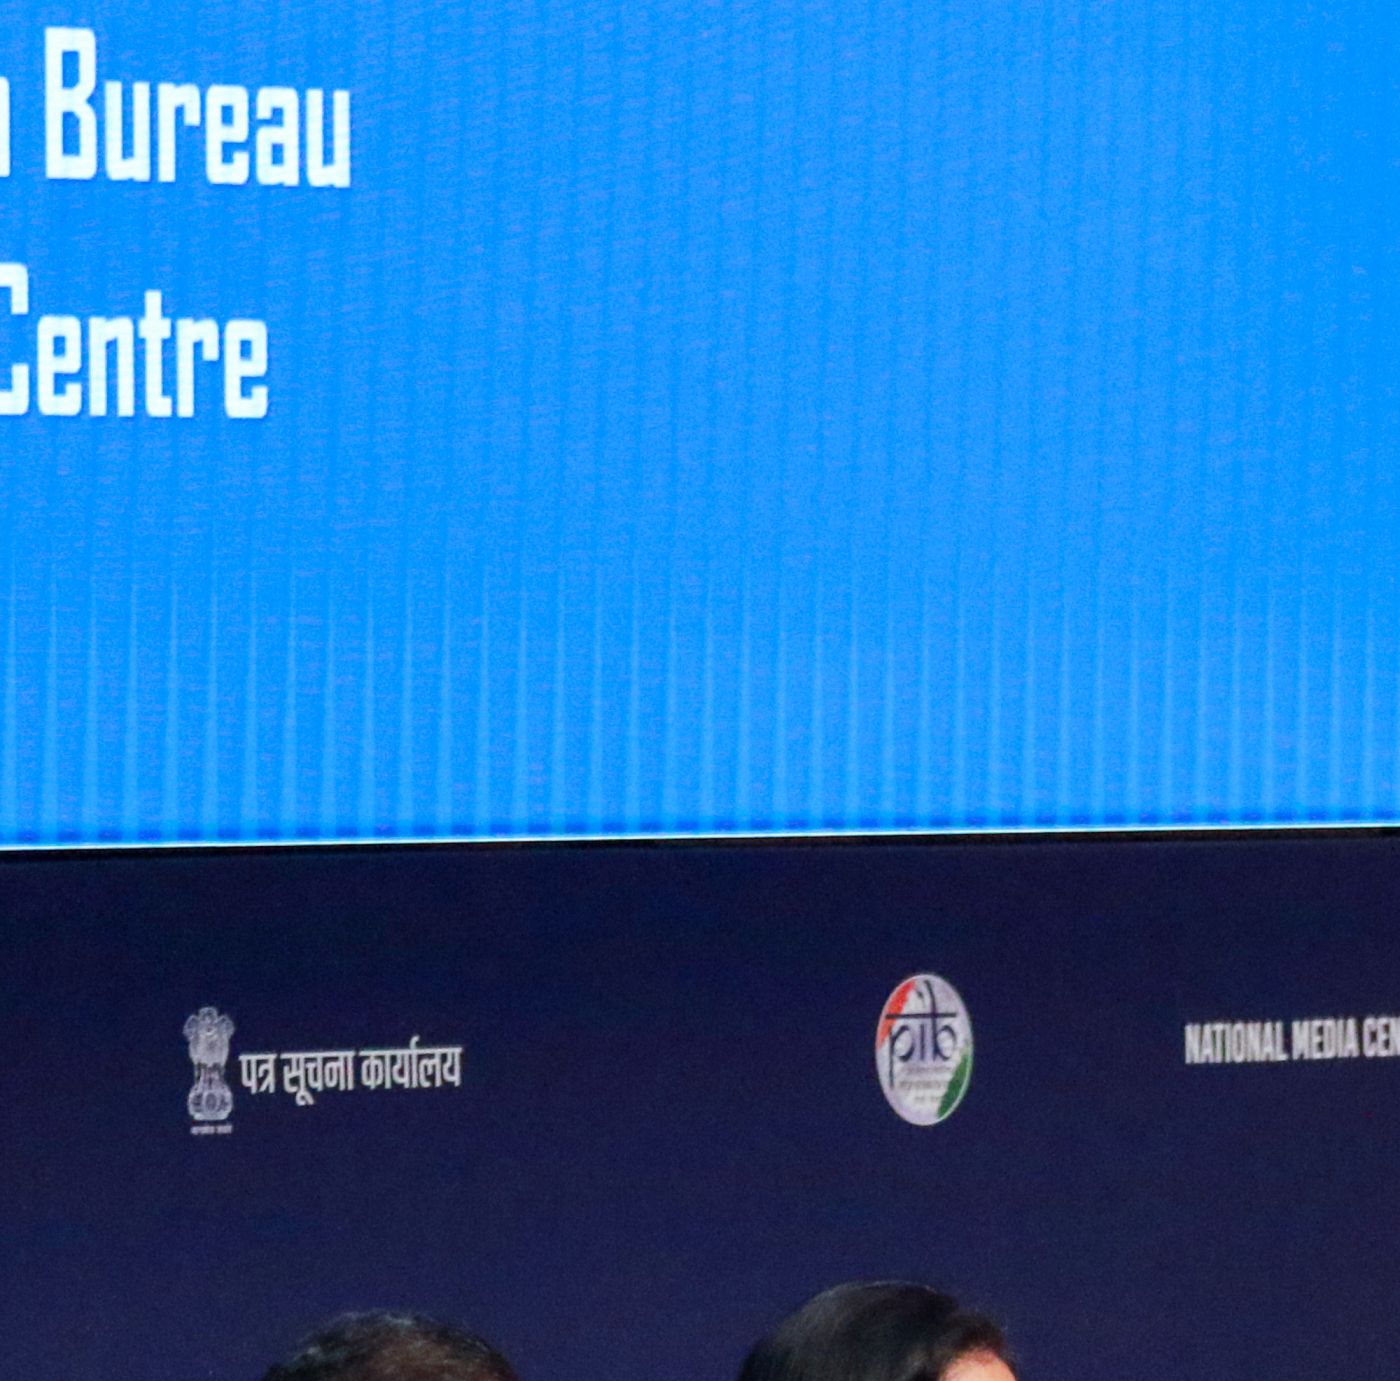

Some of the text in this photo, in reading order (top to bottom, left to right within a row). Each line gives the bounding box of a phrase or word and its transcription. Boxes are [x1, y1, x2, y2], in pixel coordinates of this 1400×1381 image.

[44, 26, 351, 188] Bureau
[238, 1035, 463, 1106] पत्र सूचना कार्यालय
[1184, 1021, 1288, 1065] NATIONAL
[1291, 1017, 1359, 1060] MEDIA
